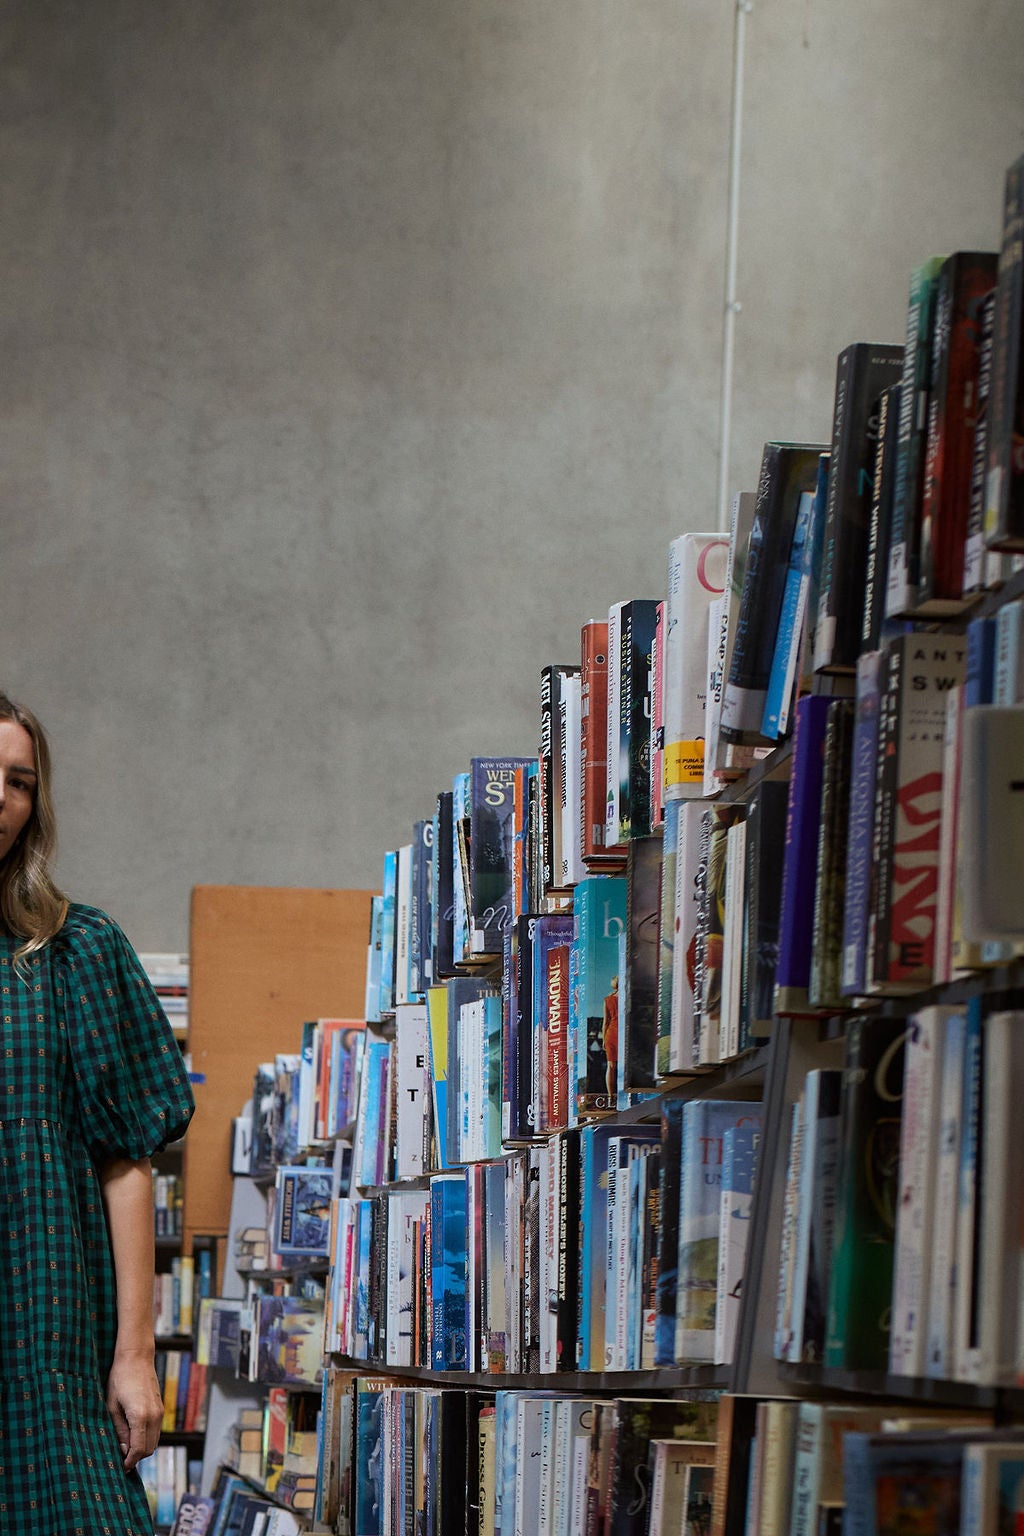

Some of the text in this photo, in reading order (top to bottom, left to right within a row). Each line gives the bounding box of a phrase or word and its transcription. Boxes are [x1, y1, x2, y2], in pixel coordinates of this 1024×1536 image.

[898, 303, 921, 444] INFORMATIONIST
[828, 380, 846, 525] CHEVY STEVENS
[873, 394, 889, 501] DAVID STEVENS
[862, 504, 881, 640] WHITE FOR DANGER
[608, 615, 616, 704] Homecoming
[714, 615, 728, 705] CAMP ZERO
[540, 672, 551, 758] MEL STEIN
[856, 737, 873, 843] ANTONIA
[549, 968, 561, 1032] NOMAD
[560, 1139, 568, 1204] SOMEONE
[478, 1432, 487, 1481] Dress
